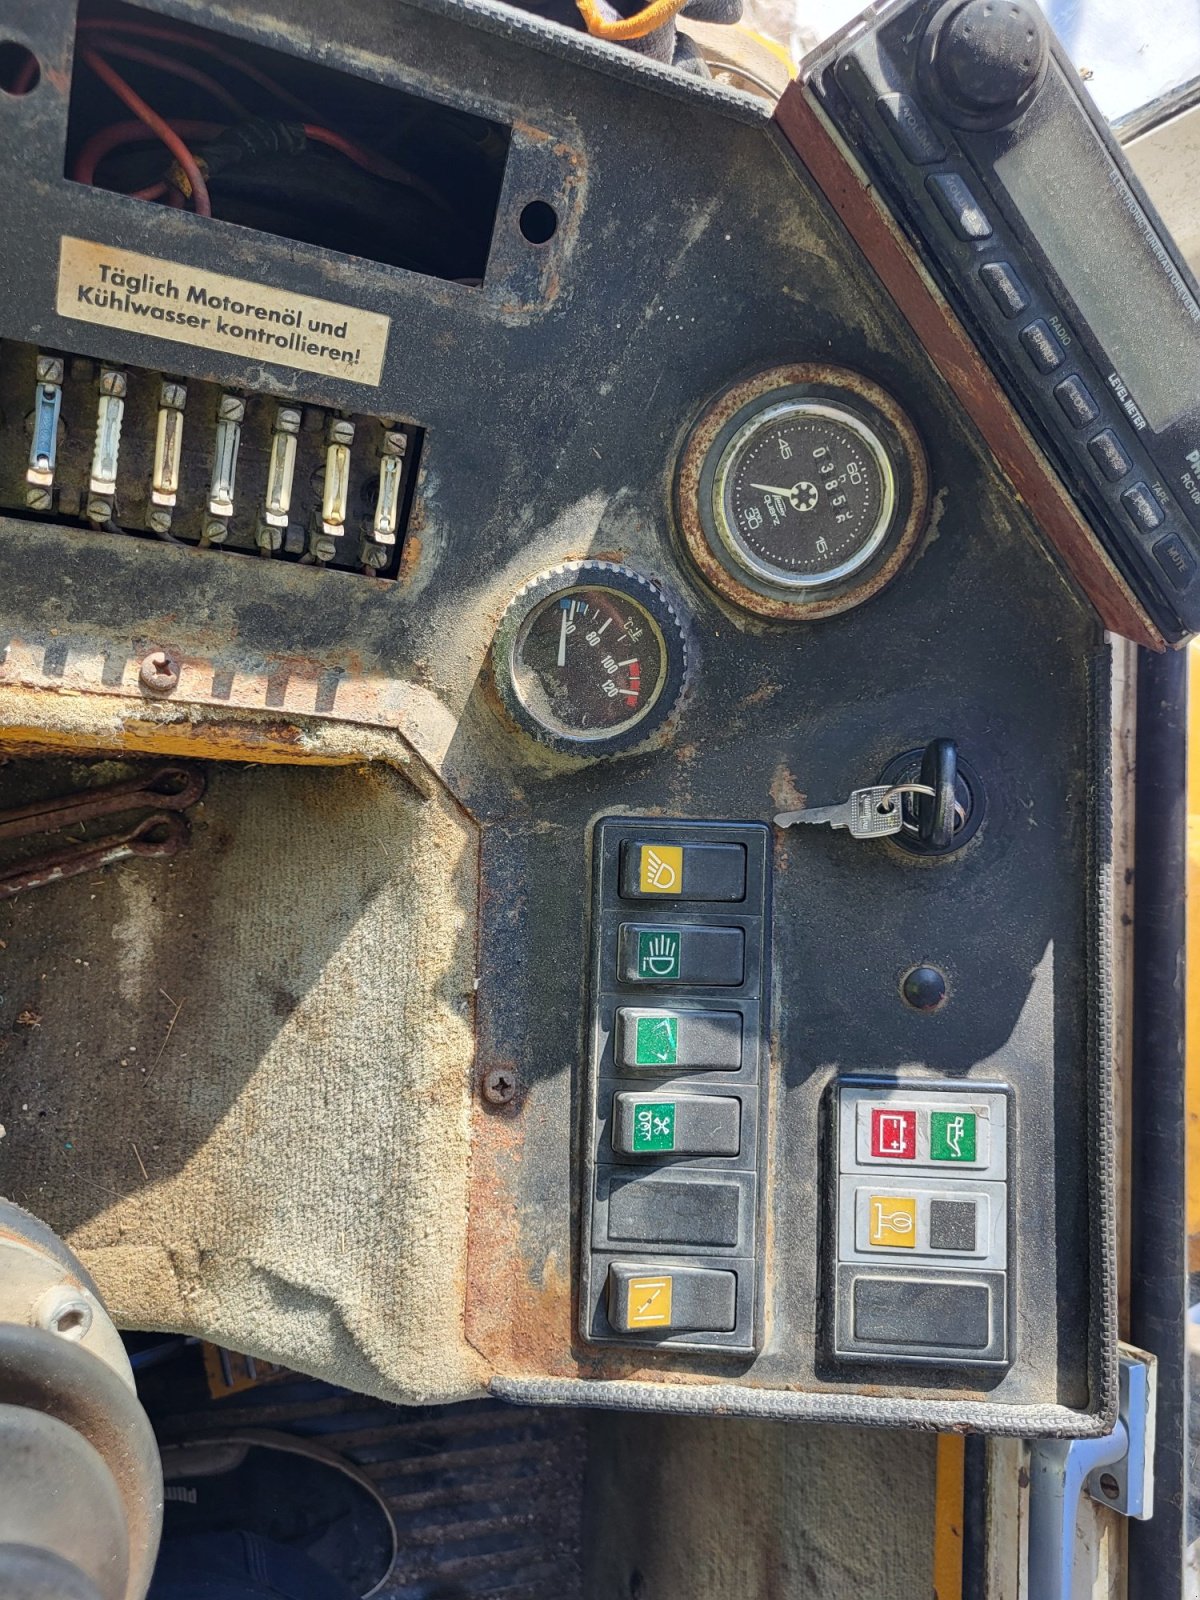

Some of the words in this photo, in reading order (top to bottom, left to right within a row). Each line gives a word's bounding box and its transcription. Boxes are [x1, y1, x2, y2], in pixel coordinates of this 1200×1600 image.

[99, 264, 180, 300] Täglich
[186, 286, 303, 328] Motorenöl
[308, 320, 348, 339] und
[77, 284, 211, 330] Kühlwasser
[216, 315, 361, 365] kontrollieren!
[1049, 315, 1072, 346] RADIO
[1107, 372, 1126, 402] LEVEL
[1124, 400, 1147, 431] METER
[778, 438, 793, 460] 45
[846, 462, 862, 485] 60
[1151, 480, 1170, 505] TAPE
[744, 508, 760, 530] 30
[763, 494, 781, 526] quarz
[815, 535, 829, 554] 15
[1167, 545, 1188, 573] MUTE
[585, 631, 601, 647] 80
[600, 655, 619, 675] 100
[601, 679, 619, 698] 120
